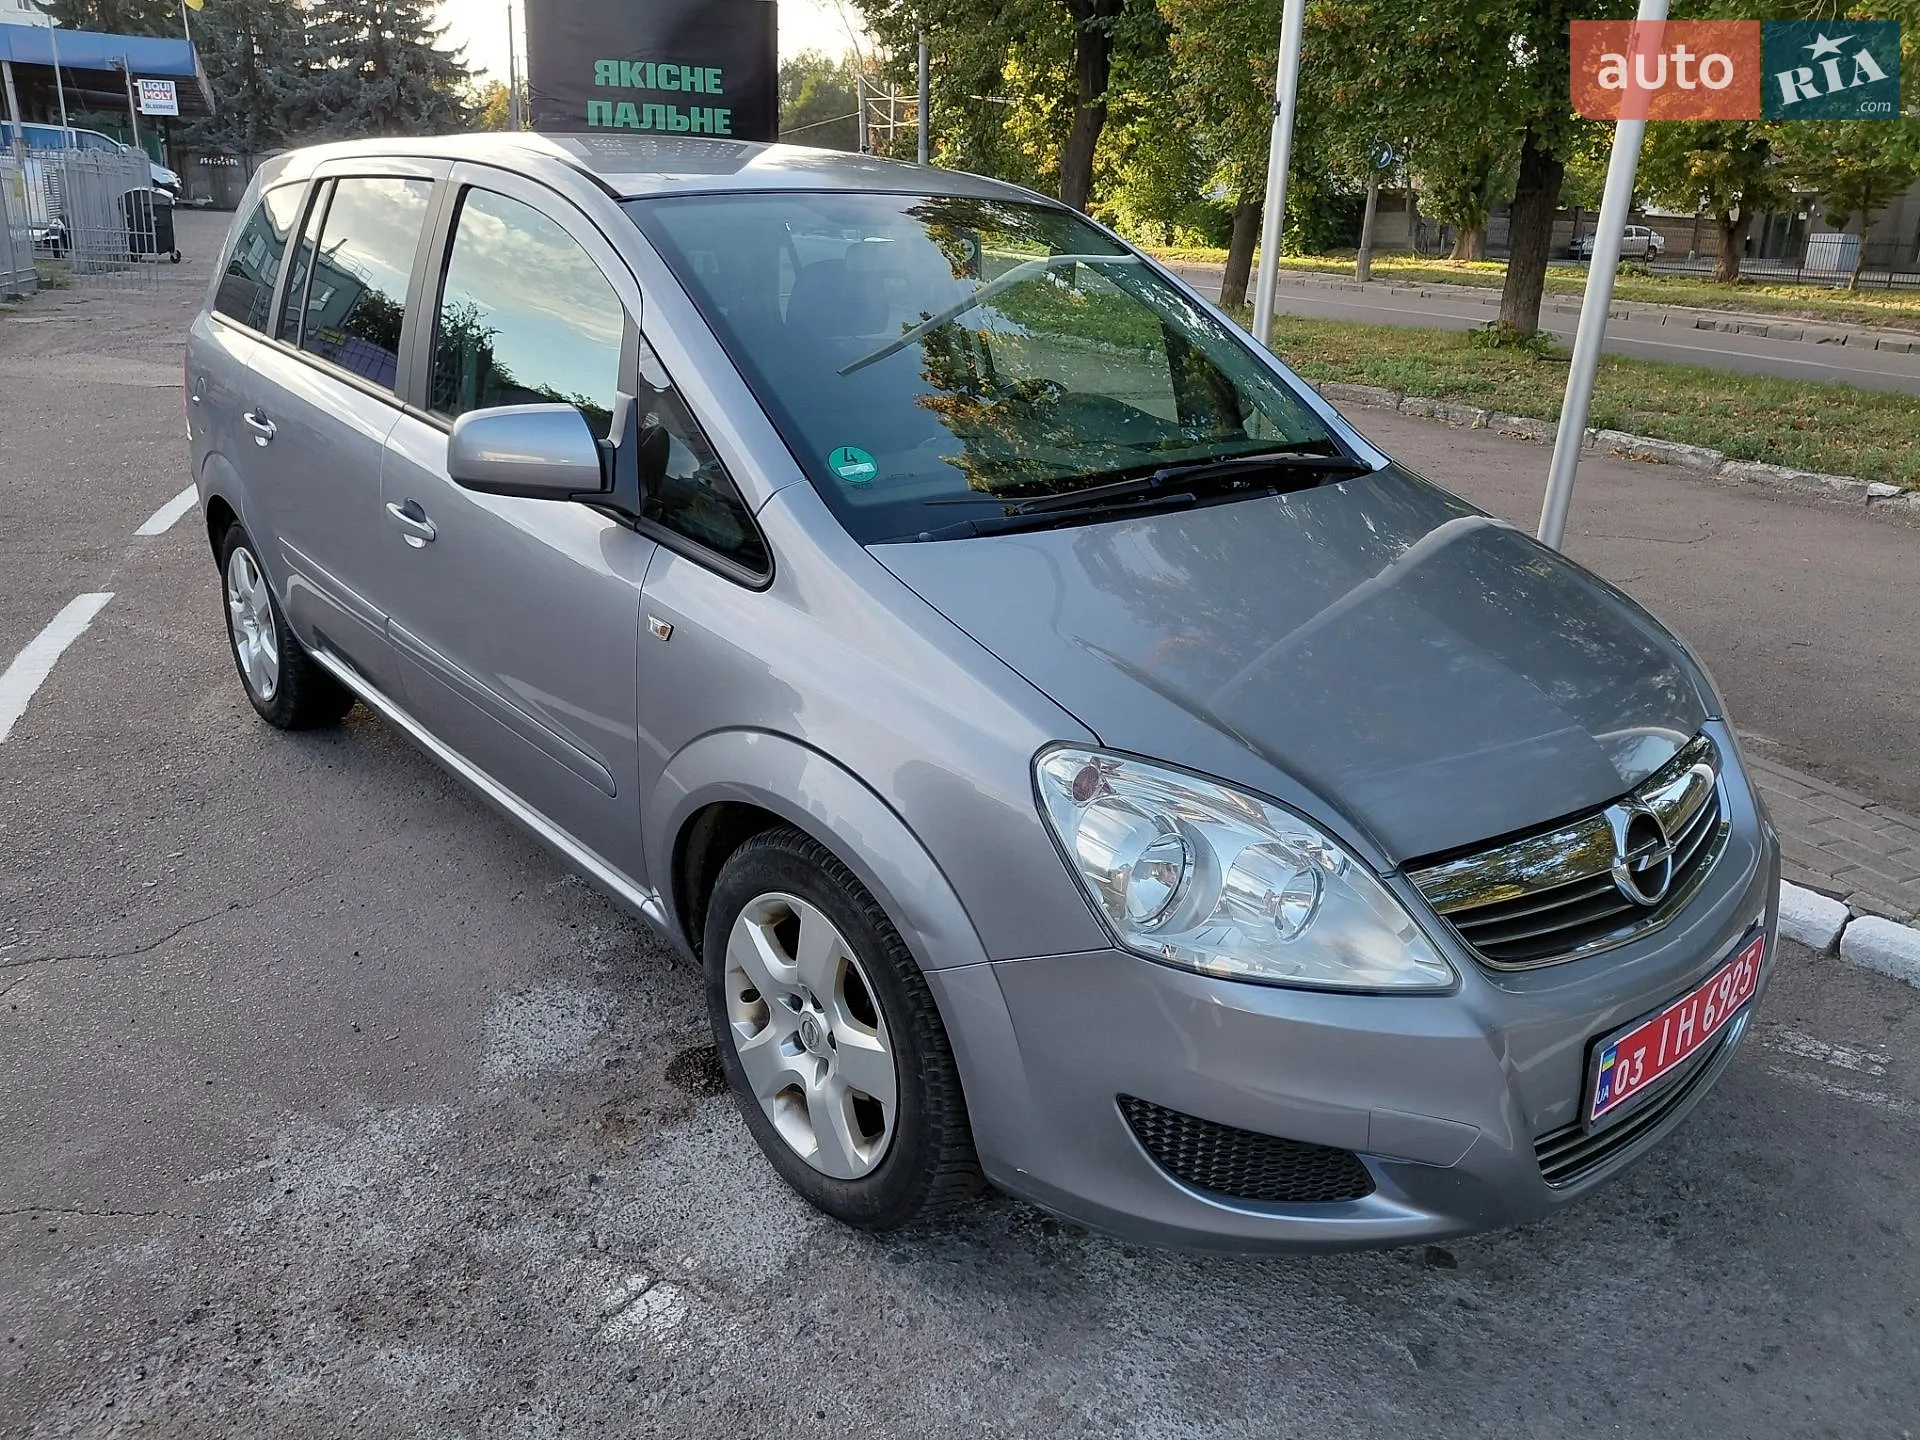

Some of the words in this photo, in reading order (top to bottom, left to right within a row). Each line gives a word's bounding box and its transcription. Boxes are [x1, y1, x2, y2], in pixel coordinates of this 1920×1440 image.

[143, 82, 171, 90] LIQUI
[594, 60, 723, 94] ЯКІСНЕ
[144, 91, 172, 100] MOLY
[588, 101, 732, 135] ПАЛЬНЕ
[1614, 1046, 1646, 1095] 03
[1702, 948, 1756, 1032] 6925
[1596, 1085, 1609, 1105] UA
